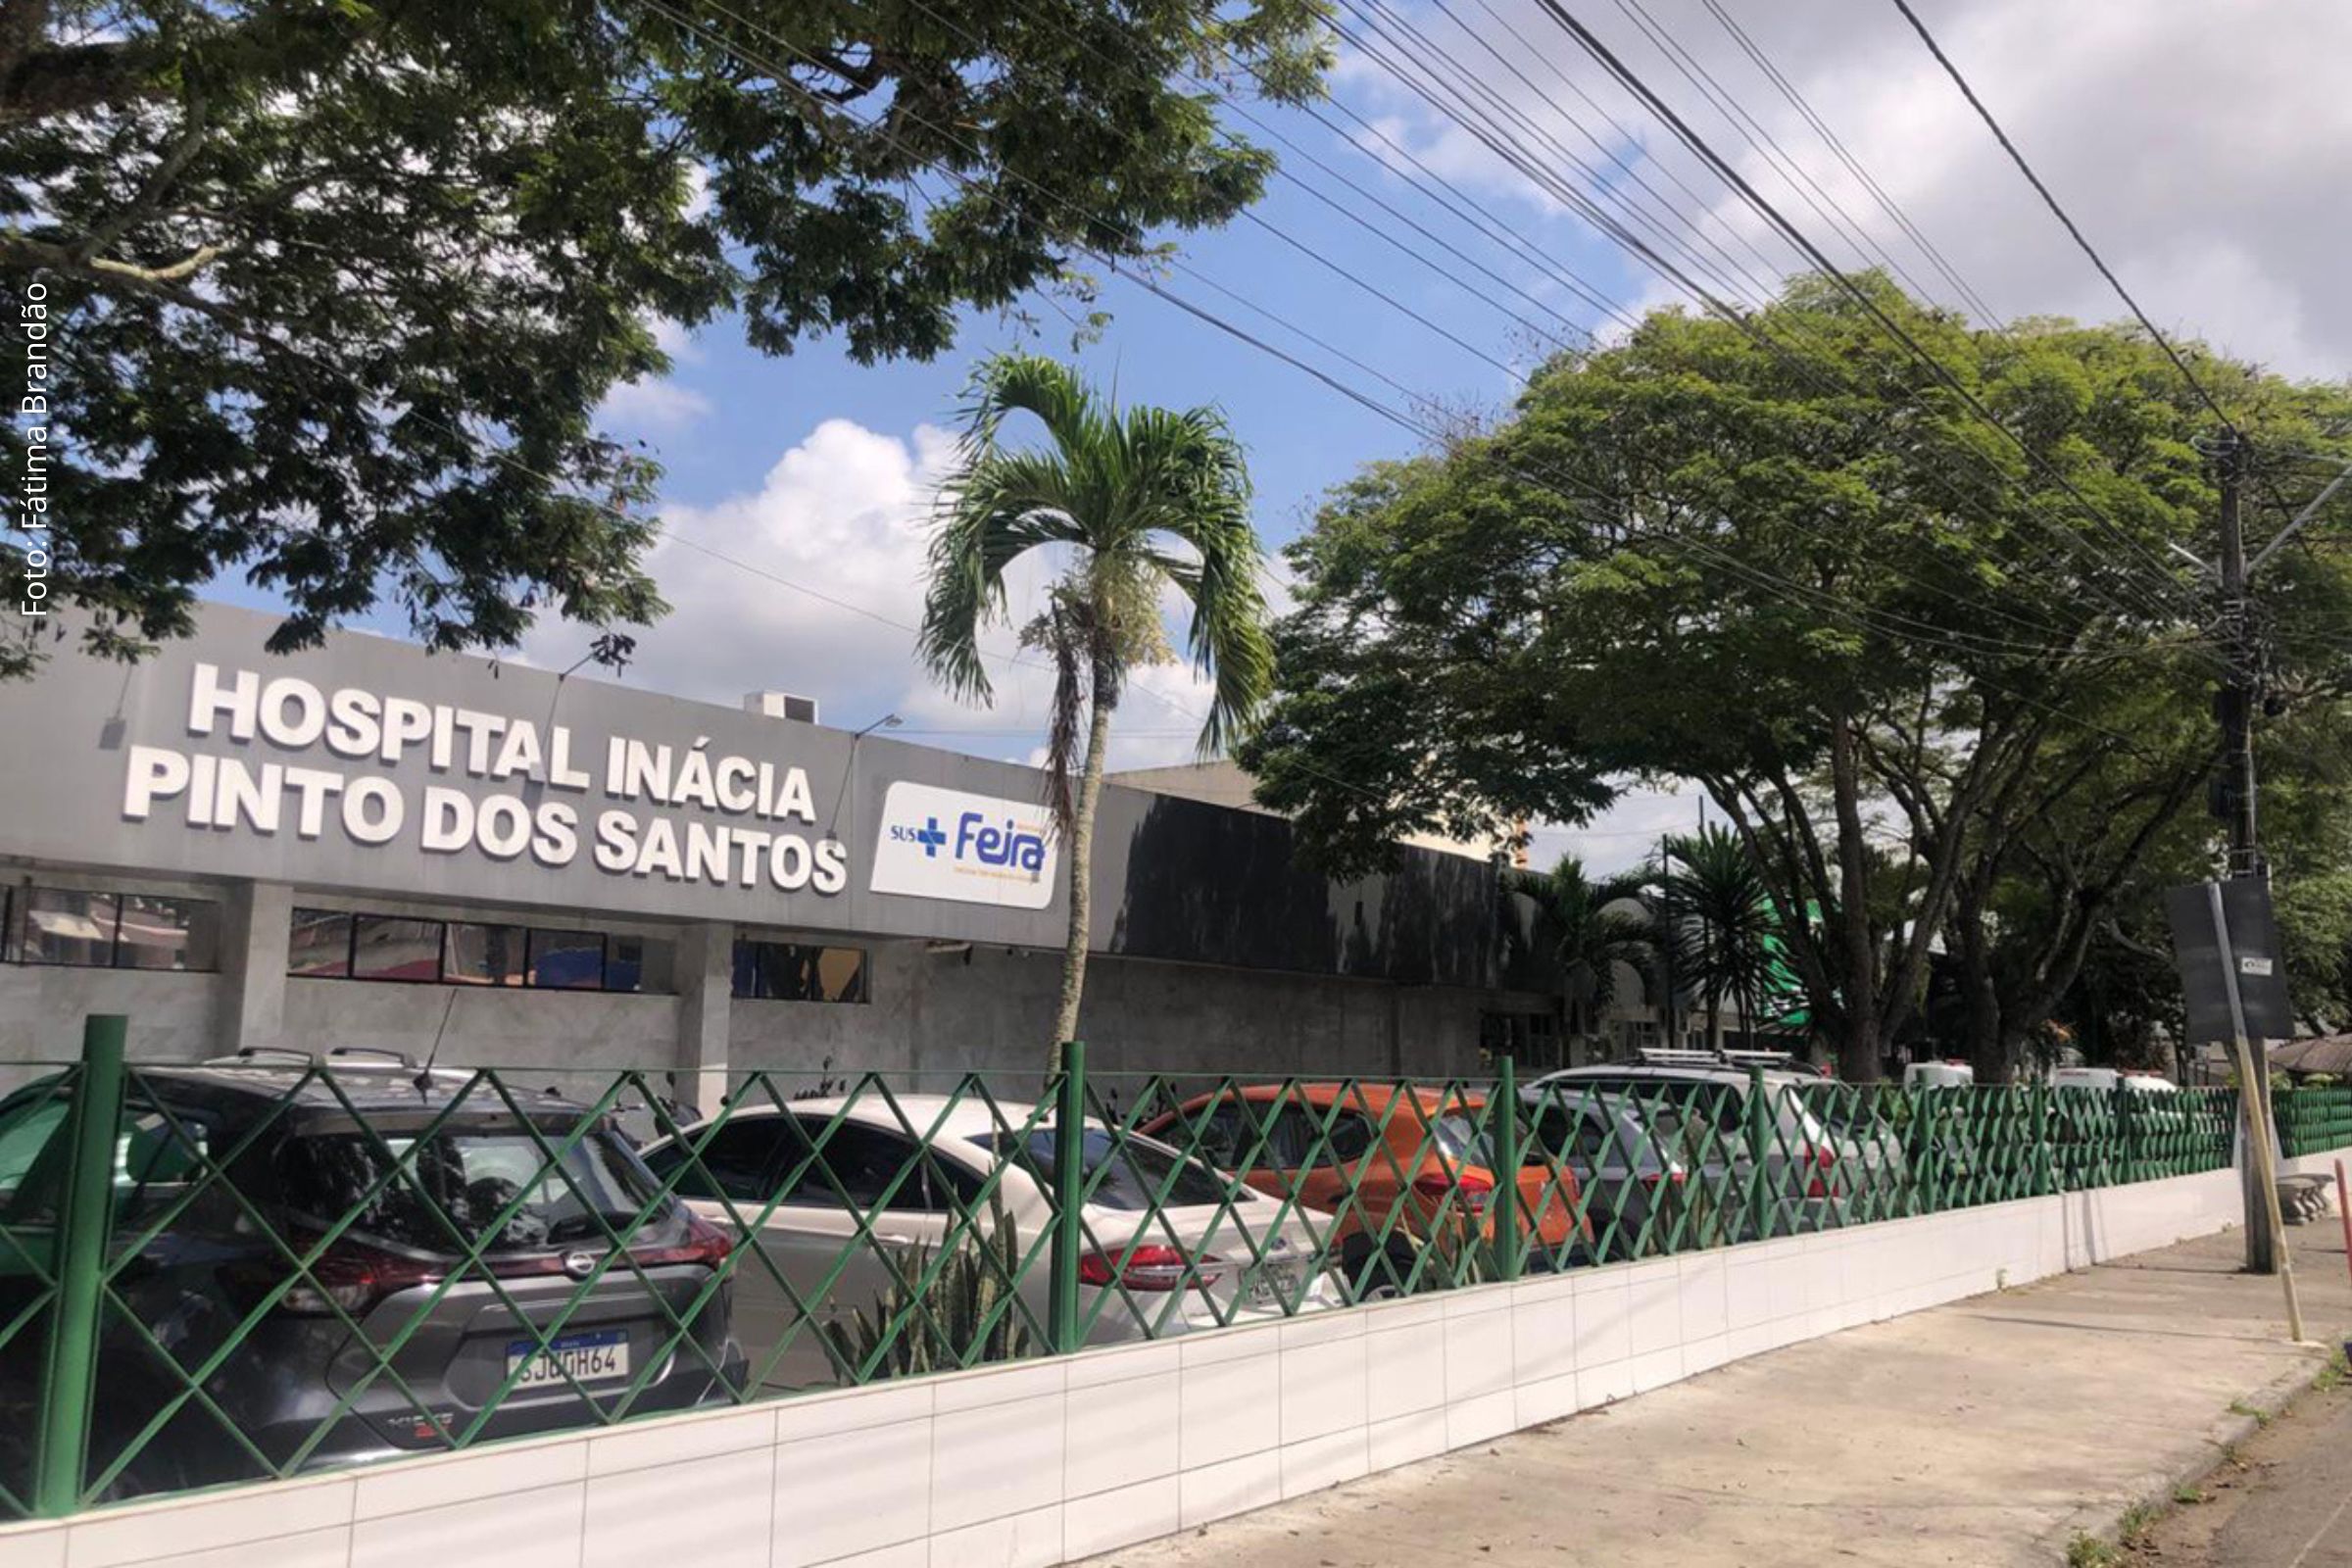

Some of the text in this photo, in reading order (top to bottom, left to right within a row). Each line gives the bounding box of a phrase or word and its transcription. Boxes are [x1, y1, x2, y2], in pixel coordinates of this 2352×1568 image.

[187, 662, 816, 823] HOSPITAL INÁCIA
[122, 745, 848, 895] PINTO DOS SANTOS
[890, 824, 917, 843] SUS
[956, 811, 1045, 870] Feira
